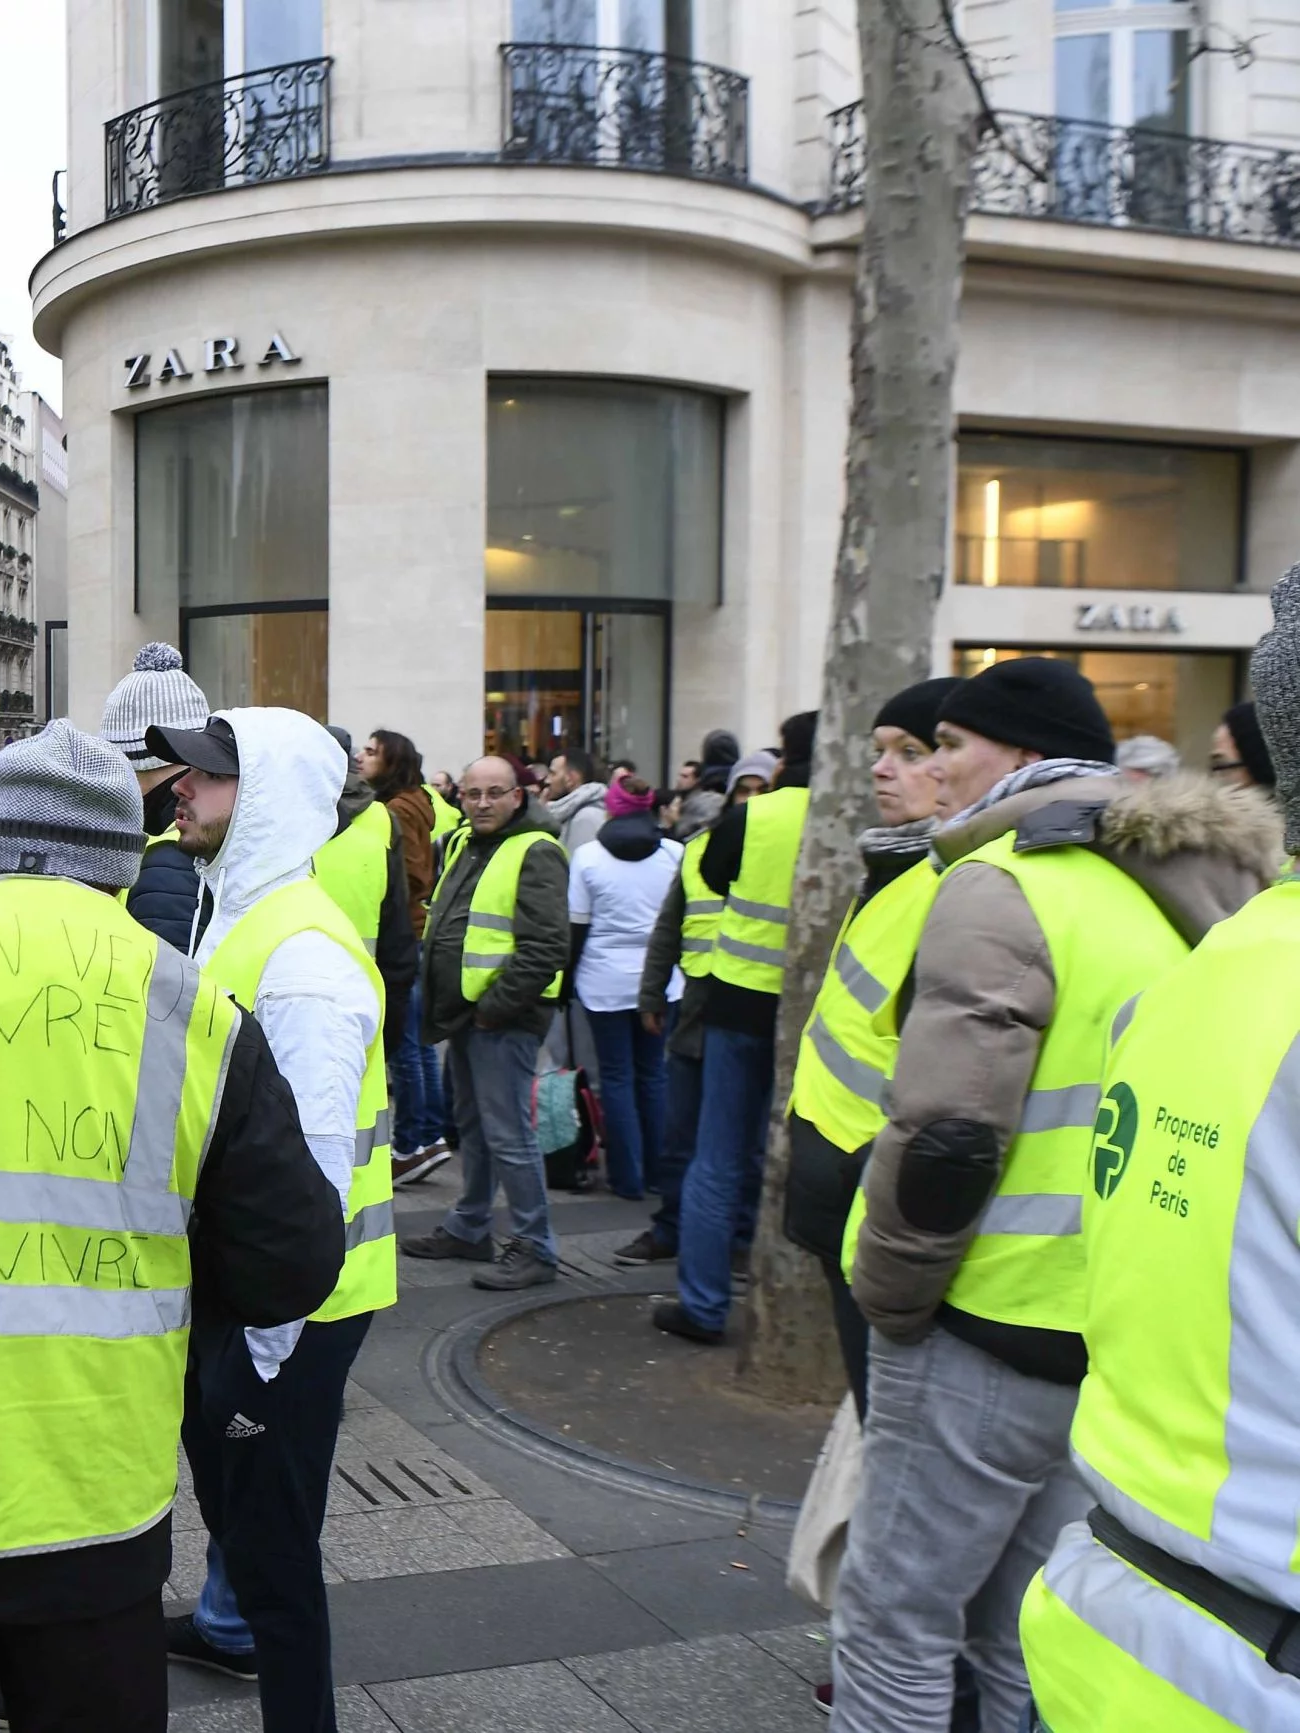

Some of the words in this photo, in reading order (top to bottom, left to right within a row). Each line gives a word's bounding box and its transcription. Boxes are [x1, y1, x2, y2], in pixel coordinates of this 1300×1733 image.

[124, 330, 302, 388] ZARA
[1075, 603, 1189, 633] ZARA
[25, 1098, 138, 1173] NON
[1153, 1106, 1221, 1149] Propreté
[1167, 1150, 1186, 1176] de
[1149, 1180, 1189, 1218] Paris
[225, 1423, 266, 1438] adidas
